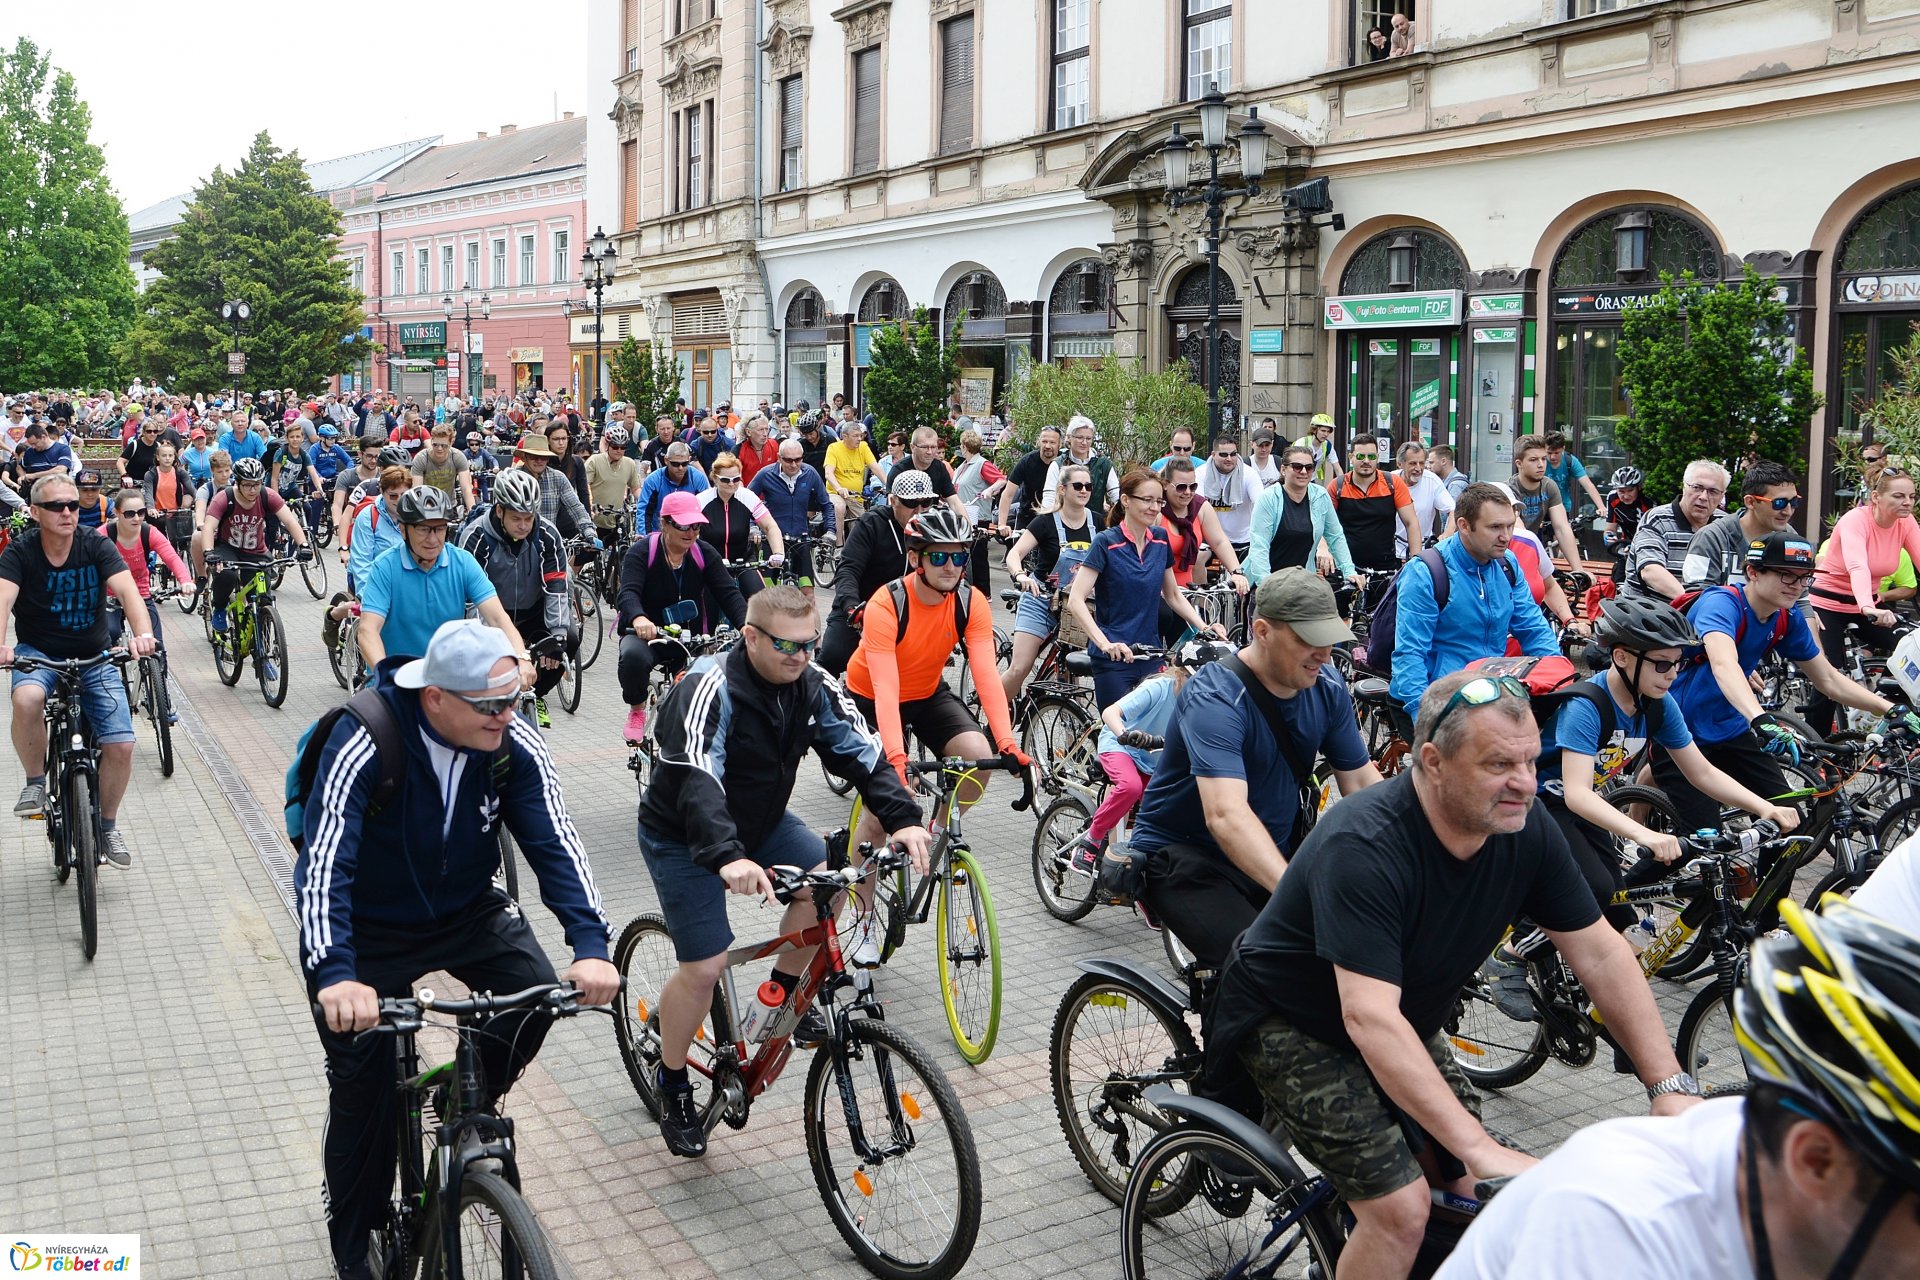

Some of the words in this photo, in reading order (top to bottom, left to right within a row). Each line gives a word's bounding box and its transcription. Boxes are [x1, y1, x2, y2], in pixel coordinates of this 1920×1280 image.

[1356, 306, 1369, 318] Fuji
[1370, 305, 1387, 316] Foto
[1388, 304, 1419, 315] Centrum
[1425, 301, 1448, 314] FDF
[404, 324, 440, 339] NYÍRSÉG
[47, 565, 98, 593] TESTO
